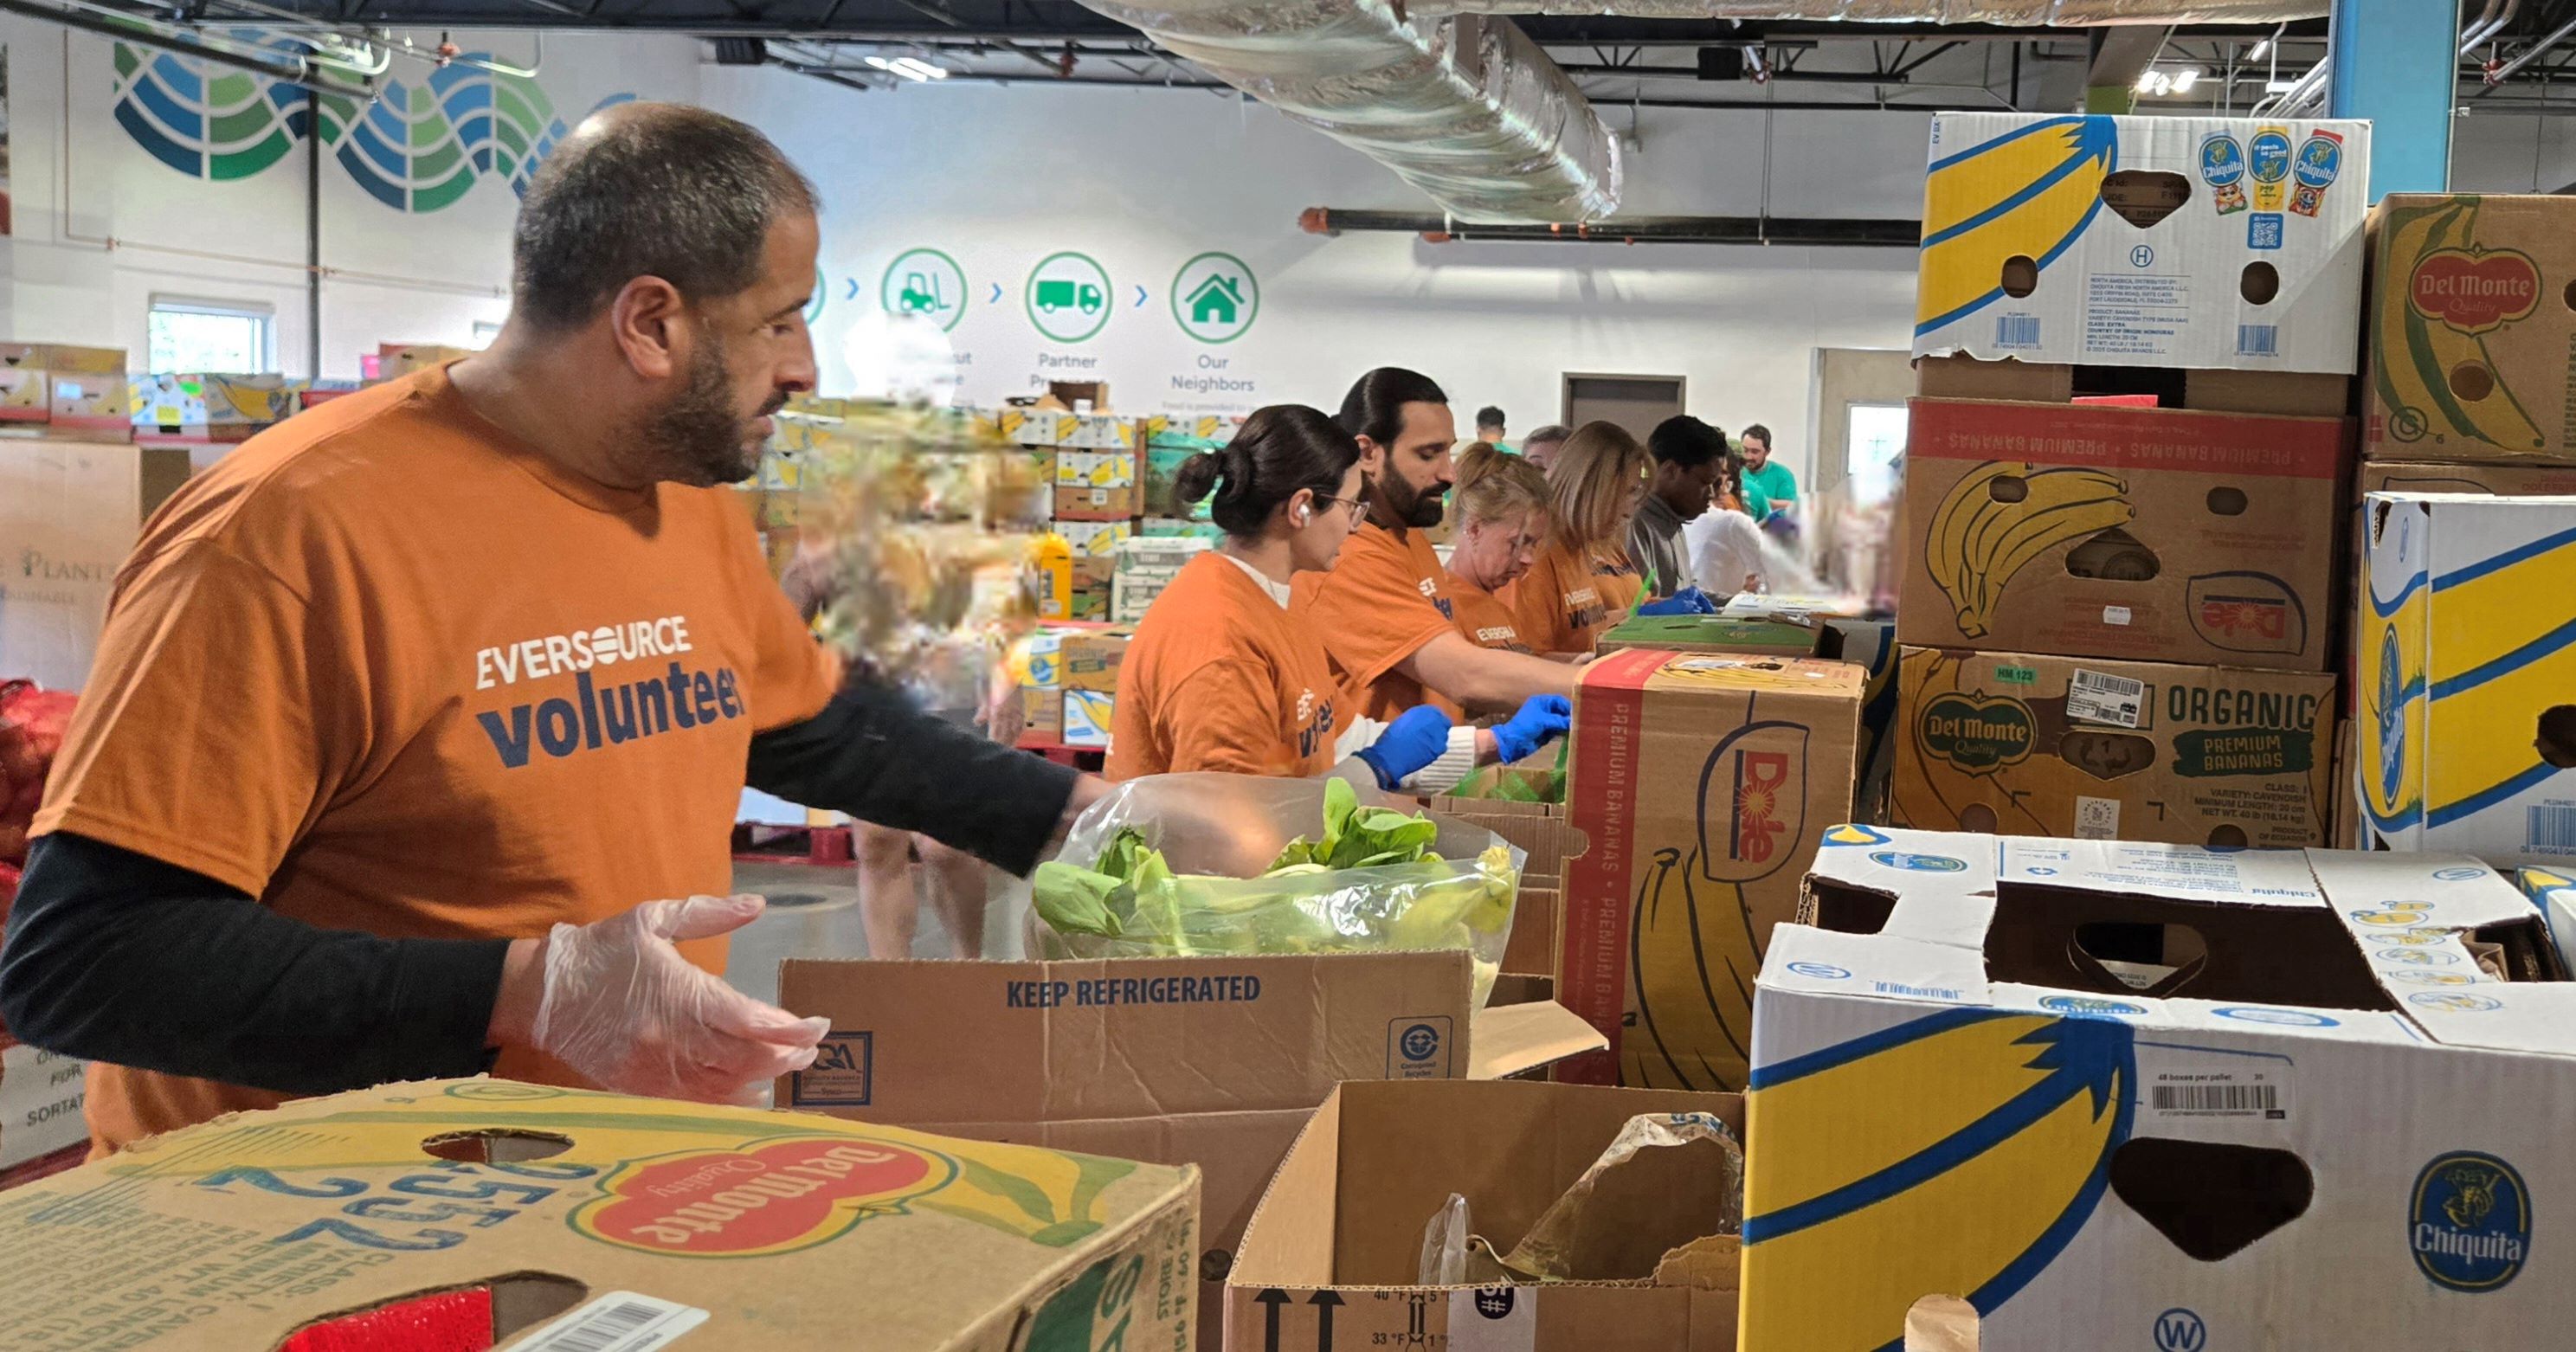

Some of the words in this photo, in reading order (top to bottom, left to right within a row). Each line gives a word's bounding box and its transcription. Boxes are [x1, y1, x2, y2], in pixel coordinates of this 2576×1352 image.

[2203, 160, 2244, 179] Chiquita
[2295, 159, 2336, 182] Chiquita
[2135, 248, 2148, 263] H
[2420, 274, 2455, 295] Del
[2459, 275, 2530, 298] Monte
[2449, 297, 2496, 315] Quality
[1039, 352, 1098, 369] Partner
[1197, 355, 1229, 370] Our
[1171, 374, 1255, 393] Neighbors
[1947, 433, 2025, 452] BANANAS
[2030, 438, 2107, 457] PREMIUM
[2129, 441, 2208, 462] BANANAS
[2212, 445, 2291, 465] PREMIUM
[2202, 602, 2286, 640] Dole
[476, 615, 693, 691] EVERSOURCE
[1997, 667, 2014, 679] HM
[2016, 669, 2033, 681] 123
[2168, 685, 2316, 731] ORGANIC
[1929, 715, 1961, 737] Del
[1964, 718, 2028, 743] Monte
[1608, 702, 1631, 782] PREMIUM
[1954, 739, 1998, 757] Quality
[2204, 735, 2282, 754] PREMIUM
[2204, 752, 2283, 772] BANANAS
[2210, 789, 2251, 799] VARIETY:
[2252, 791, 2308, 803] CAVENDISH
[2264, 782, 2299, 792] CLASS:
[1738, 750, 1789, 864] Dole
[2194, 796, 2236, 808] MINIMUM
[2237, 799, 2277, 811] LENGTH:
[2201, 807, 2221, 816] NET
[2239, 810, 2251, 819] 40
[1600, 782, 1625, 872] BANANAS
[2271, 826, 2308, 834] PRODUCT
[2251, 887, 2317, 900] Chiquita
[1594, 897, 1618, 980] PREMIUM
[1005, 978, 1070, 1008] KEEP
[1075, 975, 1261, 1007] REFRIGERATED
[1589, 981, 1613, 1067] BANAS
[50, 1063, 83, 1086] FOR
[2158, 1073, 2167, 1082] 48
[2169, 1073, 2193, 1082] boxes
[2195, 1074, 2208, 1083] per
[2210, 1073, 2232, 1082] pallet
[782, 1145, 898, 1179] Del
[645, 1158, 767, 1198] Quality
[631, 1172, 828, 1244] Monte
[2415, 1222, 2521, 1265] Chiquita
[212, 1244, 369, 1306] VARIETY:
[271, 1251, 399, 1302] CLASS:
[115, 1283, 169, 1304] 40
[1156, 1256, 1175, 1322] STORE
[1374, 1290, 1390, 1301] 40
[1429, 1291, 1437, 1303] 5
[1372, 1332, 1386, 1346] 33
[1391, 1333, 1405, 1346] °F
[2164, 1320, 2197, 1348] W
